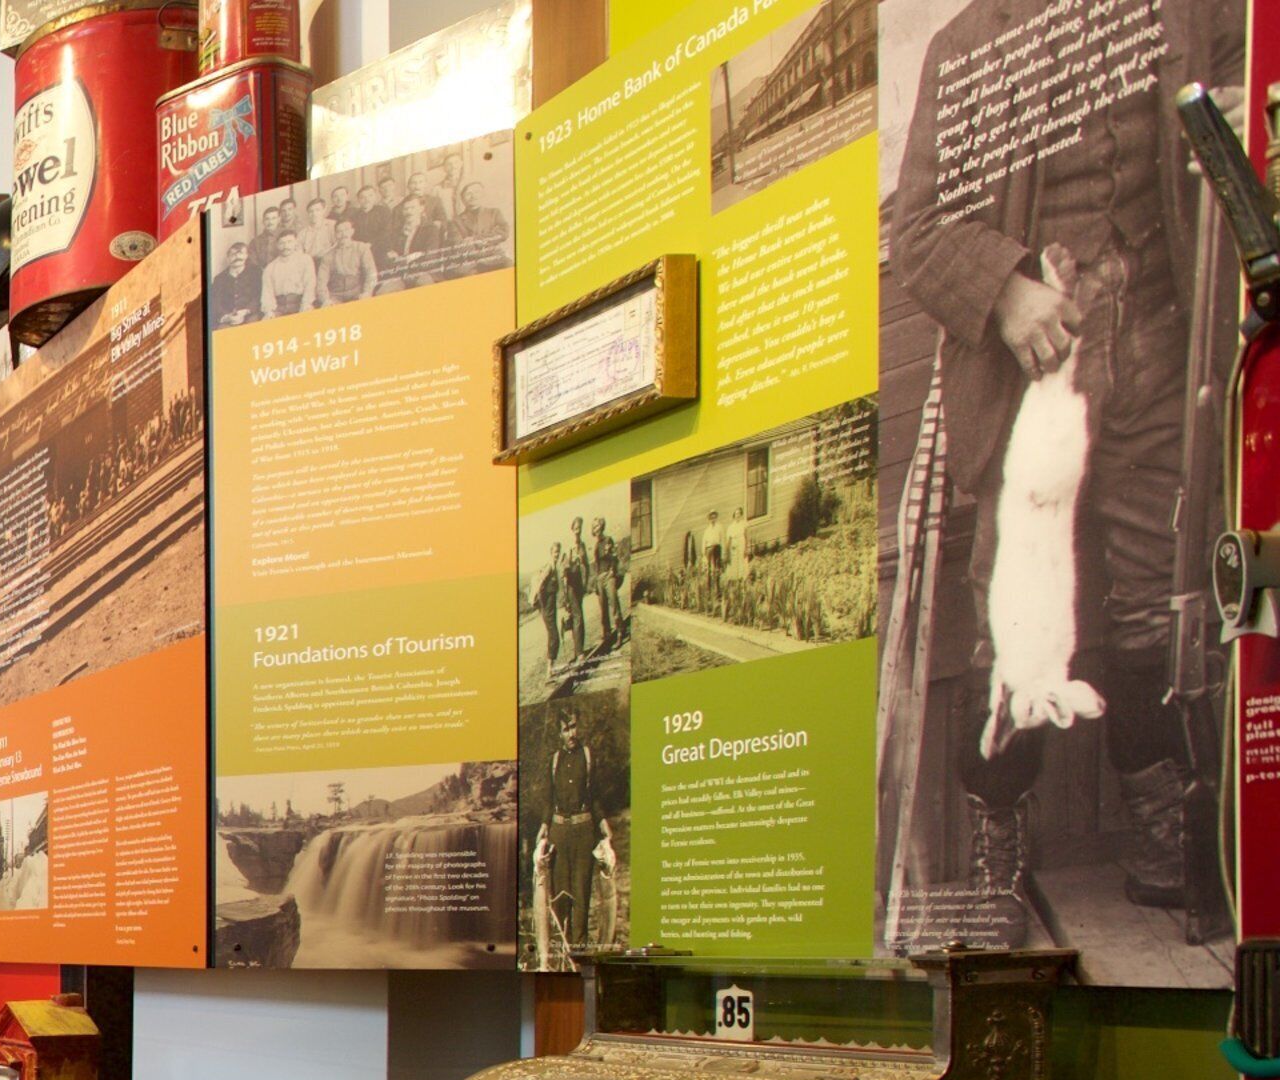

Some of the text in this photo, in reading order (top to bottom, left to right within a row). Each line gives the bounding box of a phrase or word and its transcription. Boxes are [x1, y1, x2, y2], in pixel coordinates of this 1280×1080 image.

[937, 102, 961, 121] they
[961, 87, 980, 108] all
[980, 73, 1005, 99] had
[1057, 32, 1086, 59] and
[1086, 19, 1121, 44] there
[1122, 4, 1150, 26] was
[937, 84, 945, 100] I
[945, 58, 1002, 95] remember
[1002, 34, 1043, 70] people
[938, 53, 969, 78] There
[970, 41, 993, 61] was
[994, 24, 1025, 48] some
[539, 119, 572, 154] 1923
[577, 91, 621, 130] Home
[624, 63, 661, 101] Bank
[664, 42, 683, 73] of
[684, 5, 749, 58] Canada
[936, 21, 1165, 147] group of boys that used to go hunting.
[938, 134, 974, 162] They'd
[972, 131, 988, 151] go
[987, 121, 1008, 142] get
[1008, 116, 1018, 129] a
[1051, 88, 1074, 108] cut
[1075, 82, 1088, 97] it
[1089, 73, 1108, 91] up
[1108, 52, 1139, 79] and
[1138, 42, 1170, 70] give
[15, 101, 54, 145] wift's
[161, 111, 199, 142] Blue
[937, 172, 947, 185] it
[948, 167, 960, 180] to
[962, 156, 981, 173] the
[981, 135, 1021, 169] people
[1021, 123, 1040, 145] all
[1041, 100, 1091, 136] through
[1093, 92, 1116, 111] the
[12, 136, 78, 199] ewel
[161, 130, 219, 176] Ribbon
[165, 145, 233, 206] RED LABEL
[936, 126, 1083, 207] Nothing was ever wasted.
[716, 264, 731, 277] the
[731, 252, 759, 271] Home
[758, 236, 784, 258] Bank
[783, 228, 807, 246] went
[731, 231, 762, 253] biggest
[761, 215, 786, 237] thrill
[785, 210, 804, 226] was
[717, 232, 841, 295] We had our entire savings in
[121, 307, 143, 333] Strike
[142, 313, 166, 339] Mines
[251, 337, 299, 361] 1914
[315, 324, 363, 348] 1918
[250, 350, 359, 386] World War I
[252, 633, 475, 668] Foundations of Tourism
[253, 623, 300, 644] 1921
[662, 710, 704, 735] 1929
[661, 728, 808, 766] Great Depression
[717, 995, 750, 1028] .85
